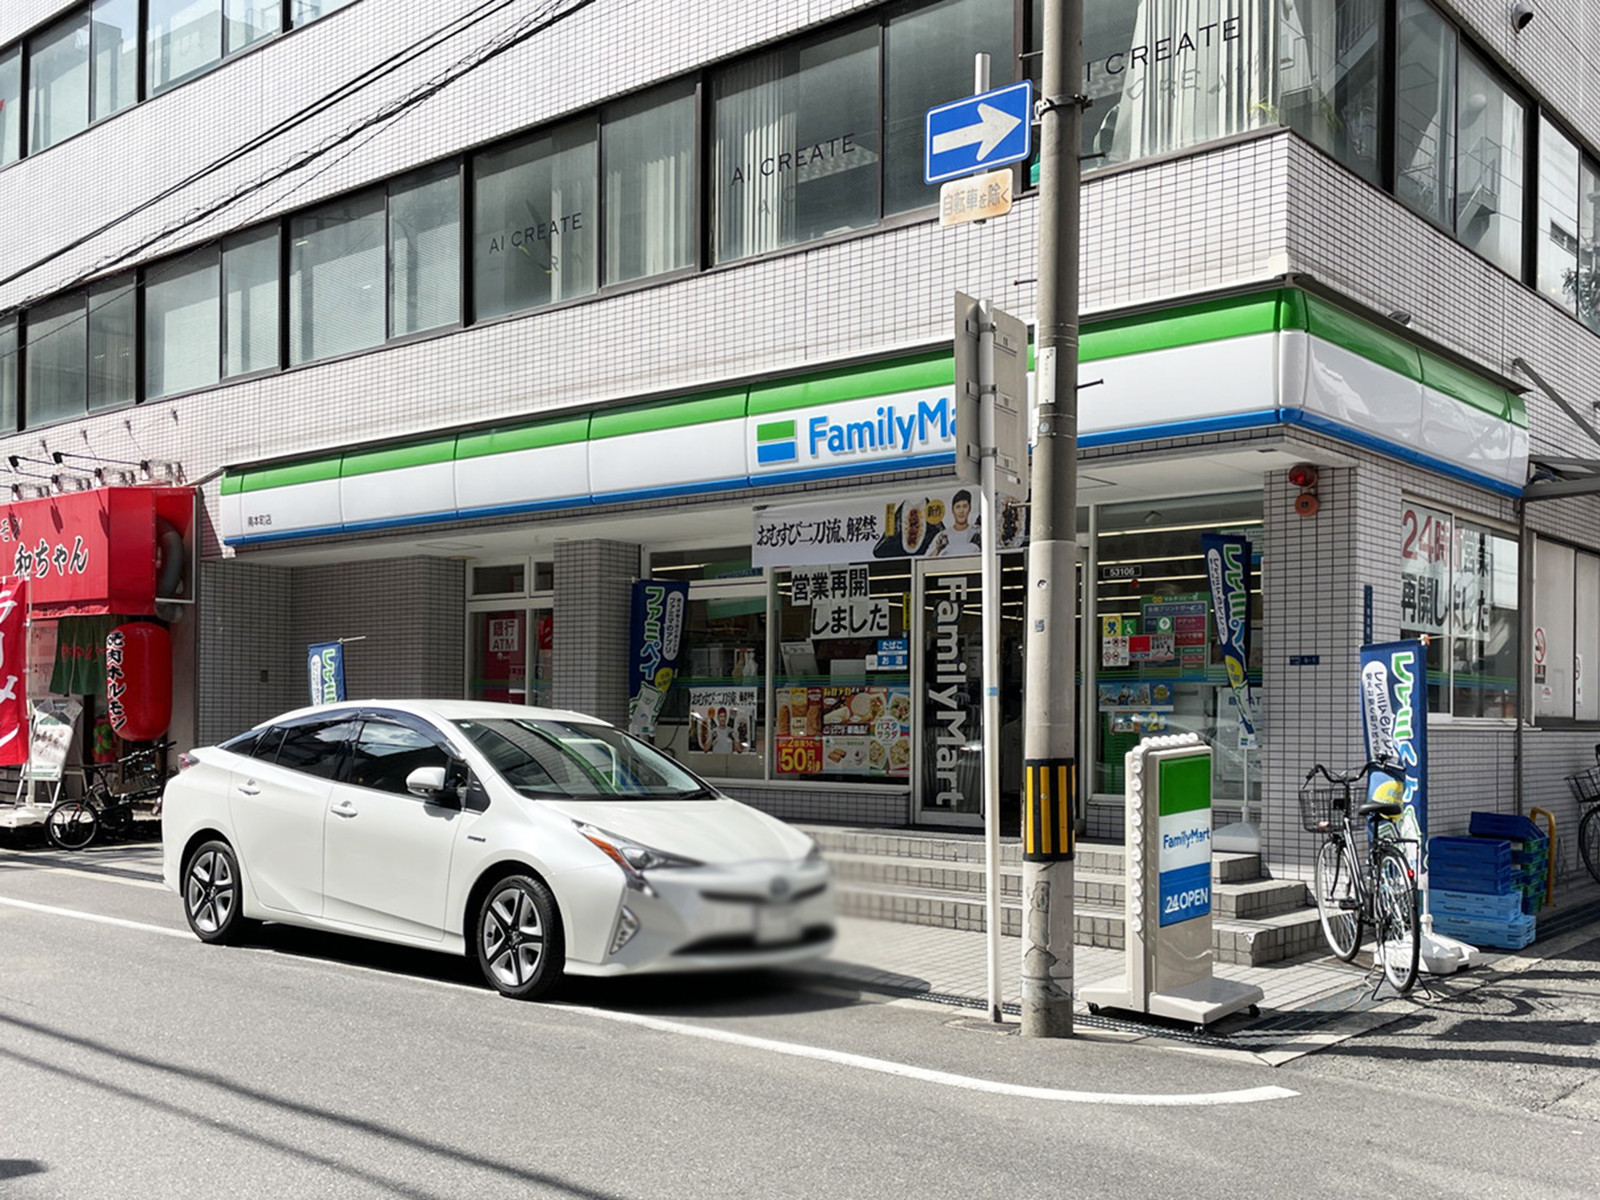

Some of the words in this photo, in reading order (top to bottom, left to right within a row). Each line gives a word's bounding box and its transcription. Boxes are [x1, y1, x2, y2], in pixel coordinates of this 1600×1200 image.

[1105, 16, 1240, 75] CREATE
[731, 163, 750, 186] AI
[760, 133, 855, 176] CREATE
[942, 182, 1009, 216] 自転車を除く
[489, 236, 504, 254] AI
[511, 212, 582, 247] CREATE
[809, 397, 956, 456] FamilyM
[13, 535, 88, 579] 和ちゃん
[1110, 567, 1135, 576] 53106
[792, 568, 868, 601] 営業再開
[640, 587, 665, 680] ファミペイ
[812, 603, 888, 635] しました
[493, 639, 515, 650] ATM
[928, 577, 967, 806] FamilyMart
[1163, 827, 1210, 849] FamilyMart
